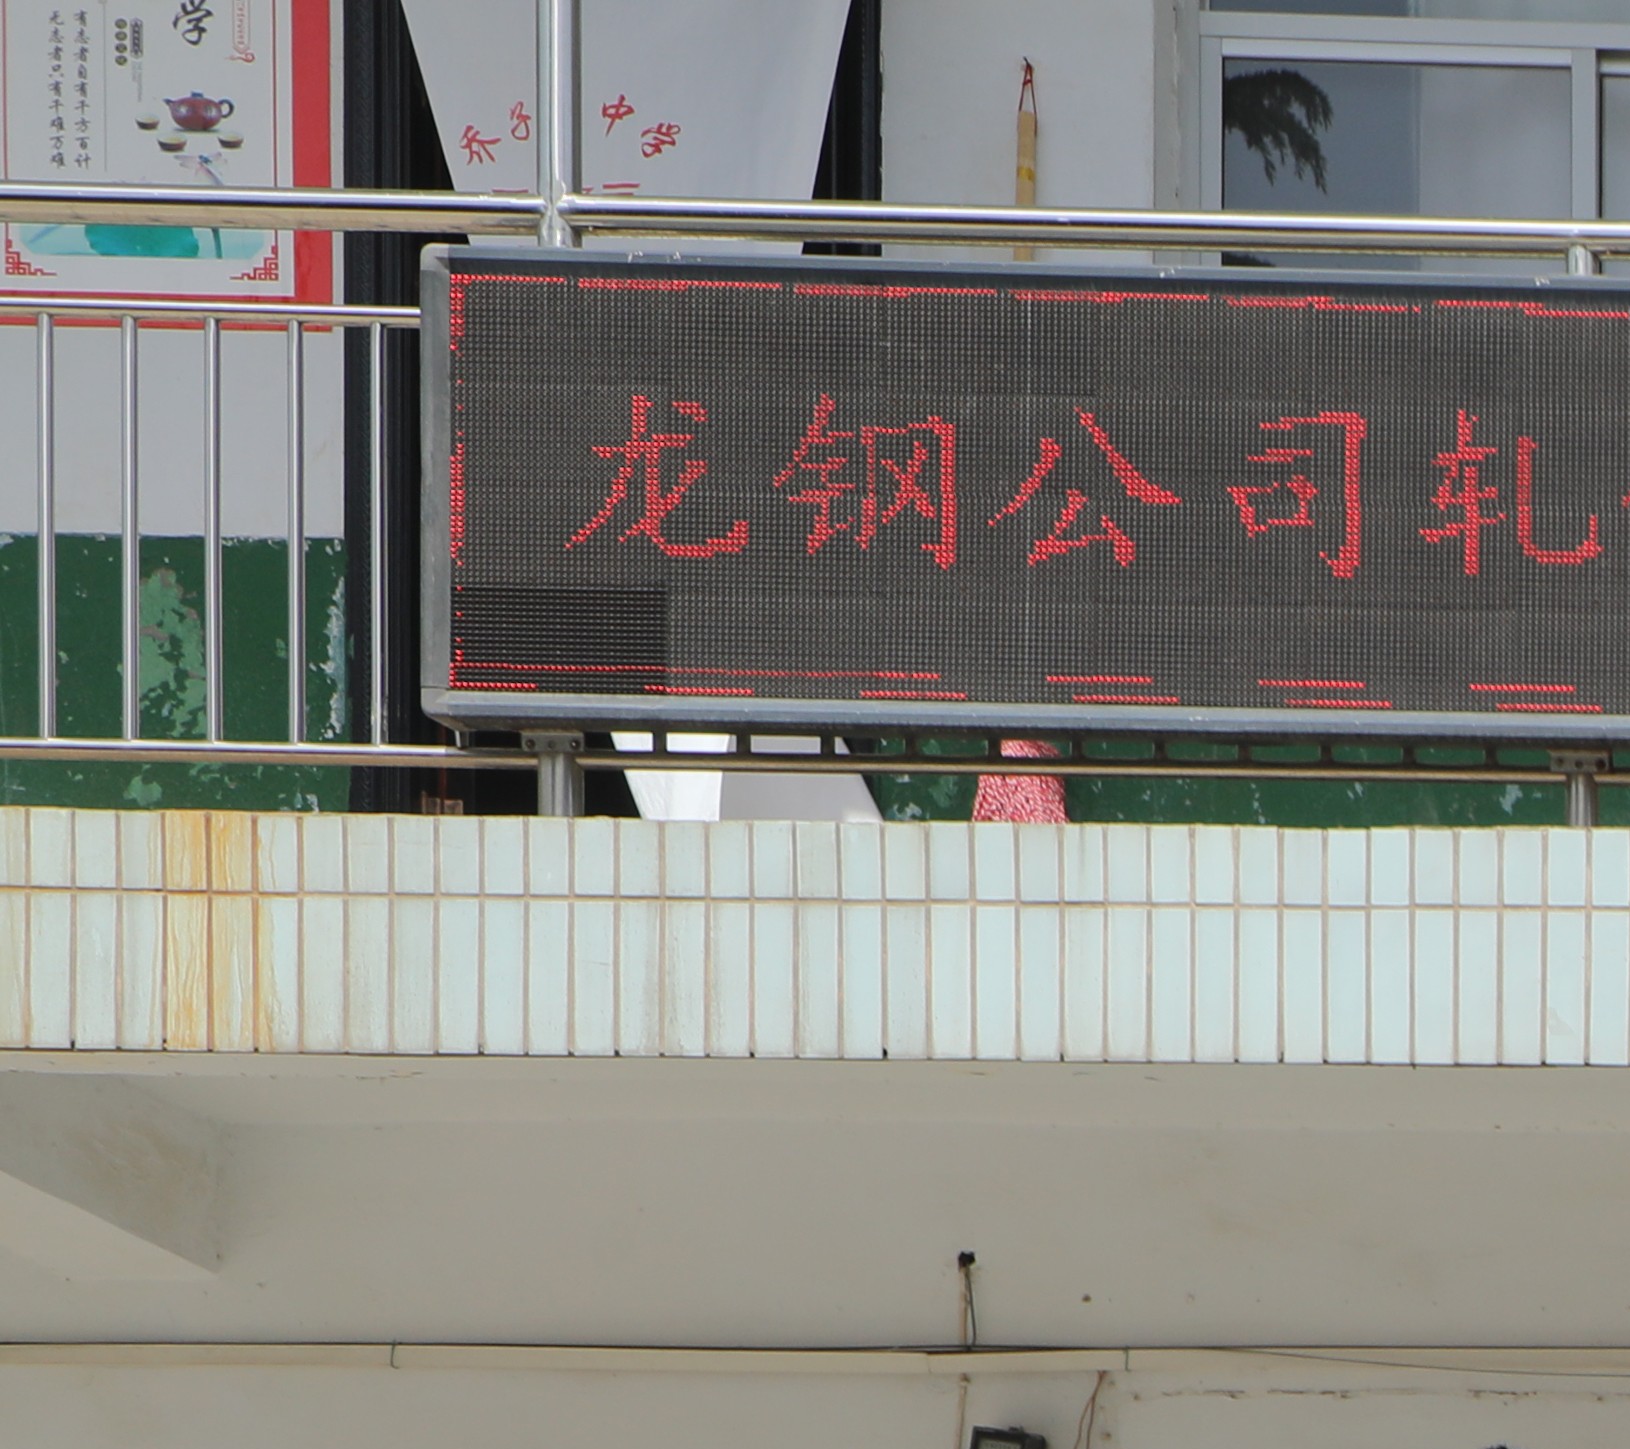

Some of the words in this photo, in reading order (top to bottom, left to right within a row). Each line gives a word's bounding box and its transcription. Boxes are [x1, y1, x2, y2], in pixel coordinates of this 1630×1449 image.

[48, 9, 67, 170] 无志者只有千难万难
[73, 9, 91, 170] 有志者自有千方百计
